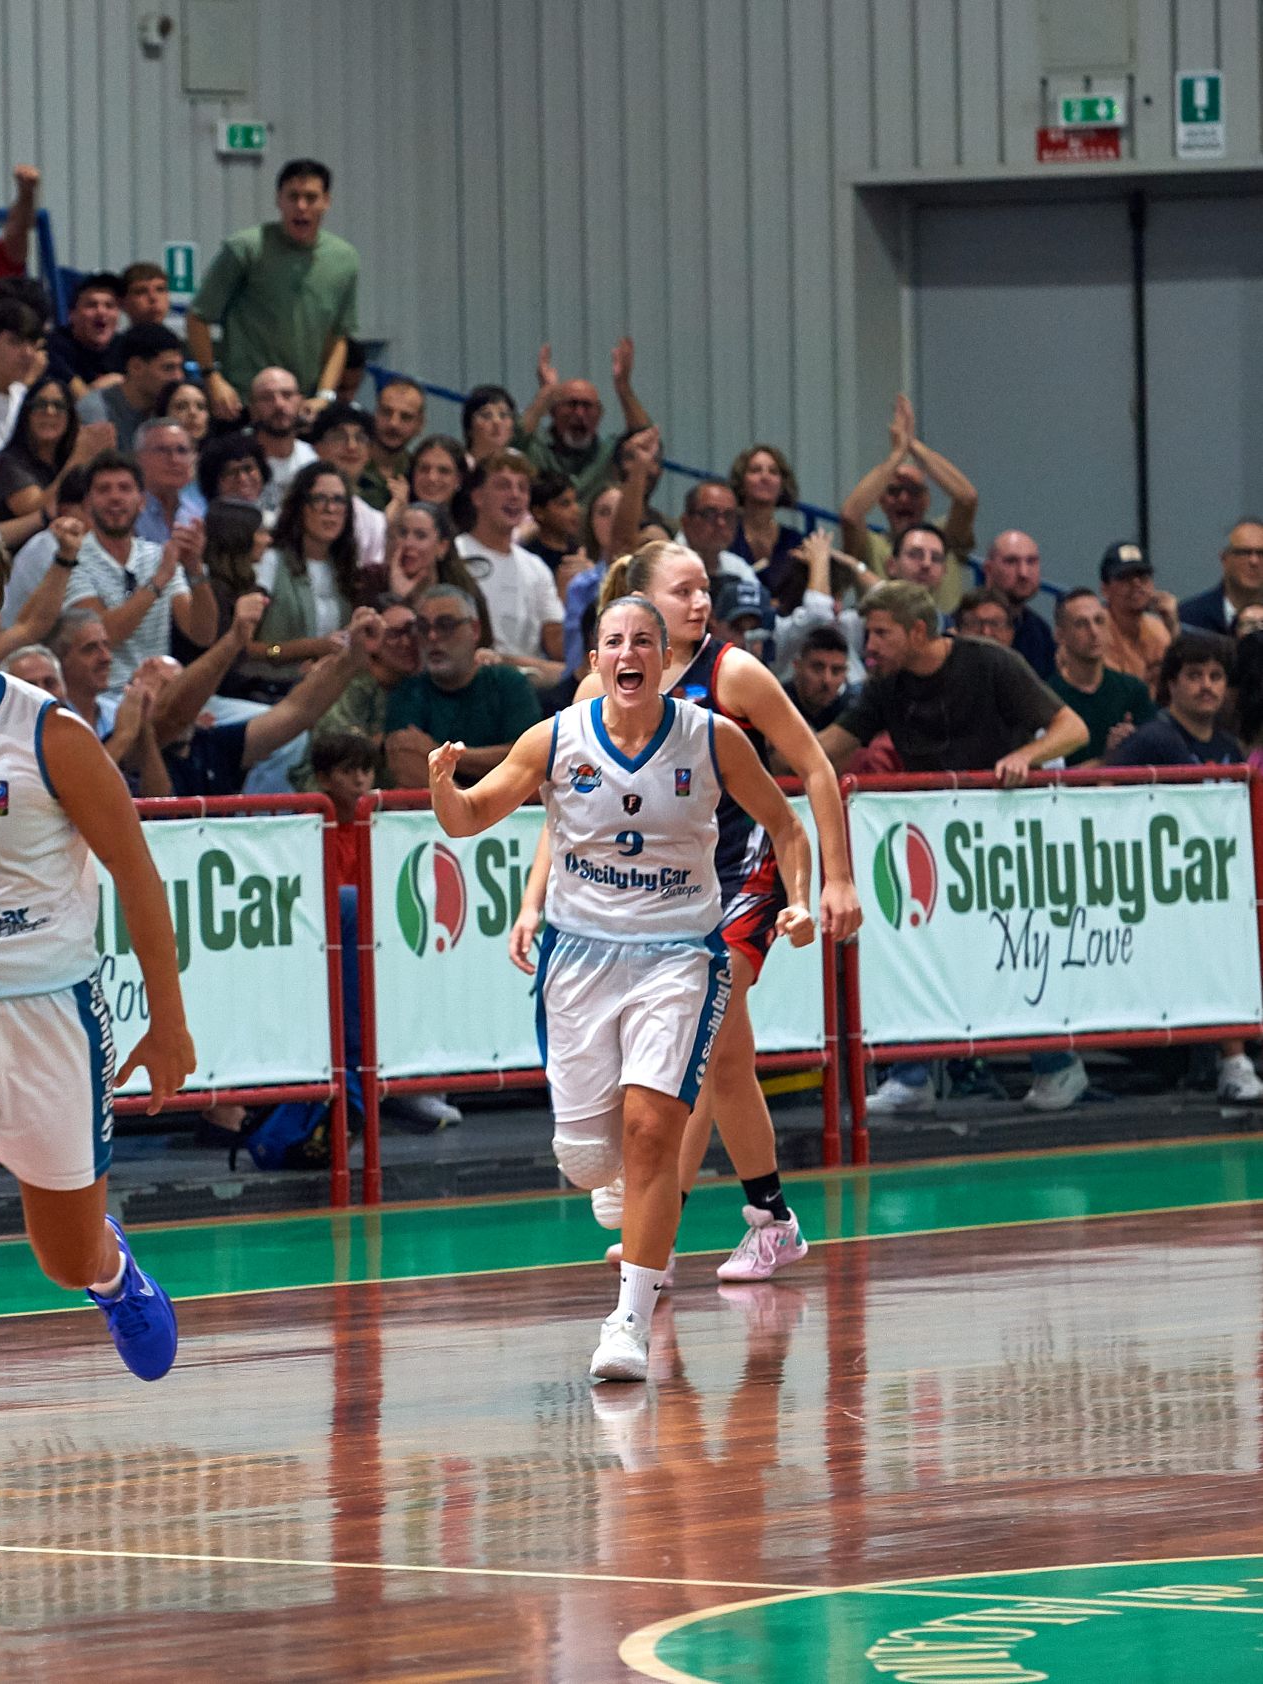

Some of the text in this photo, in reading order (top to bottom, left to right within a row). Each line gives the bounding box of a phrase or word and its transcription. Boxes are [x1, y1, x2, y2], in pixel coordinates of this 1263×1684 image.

[579, 859, 629, 890] Sicily
[659, 866, 692, 887] Car
[615, 830, 645, 857] 9
[944, 813, 1237, 928] Sicily by Car
[197, 849, 302, 951] Car
[989, 906, 1134, 1006] My Love
